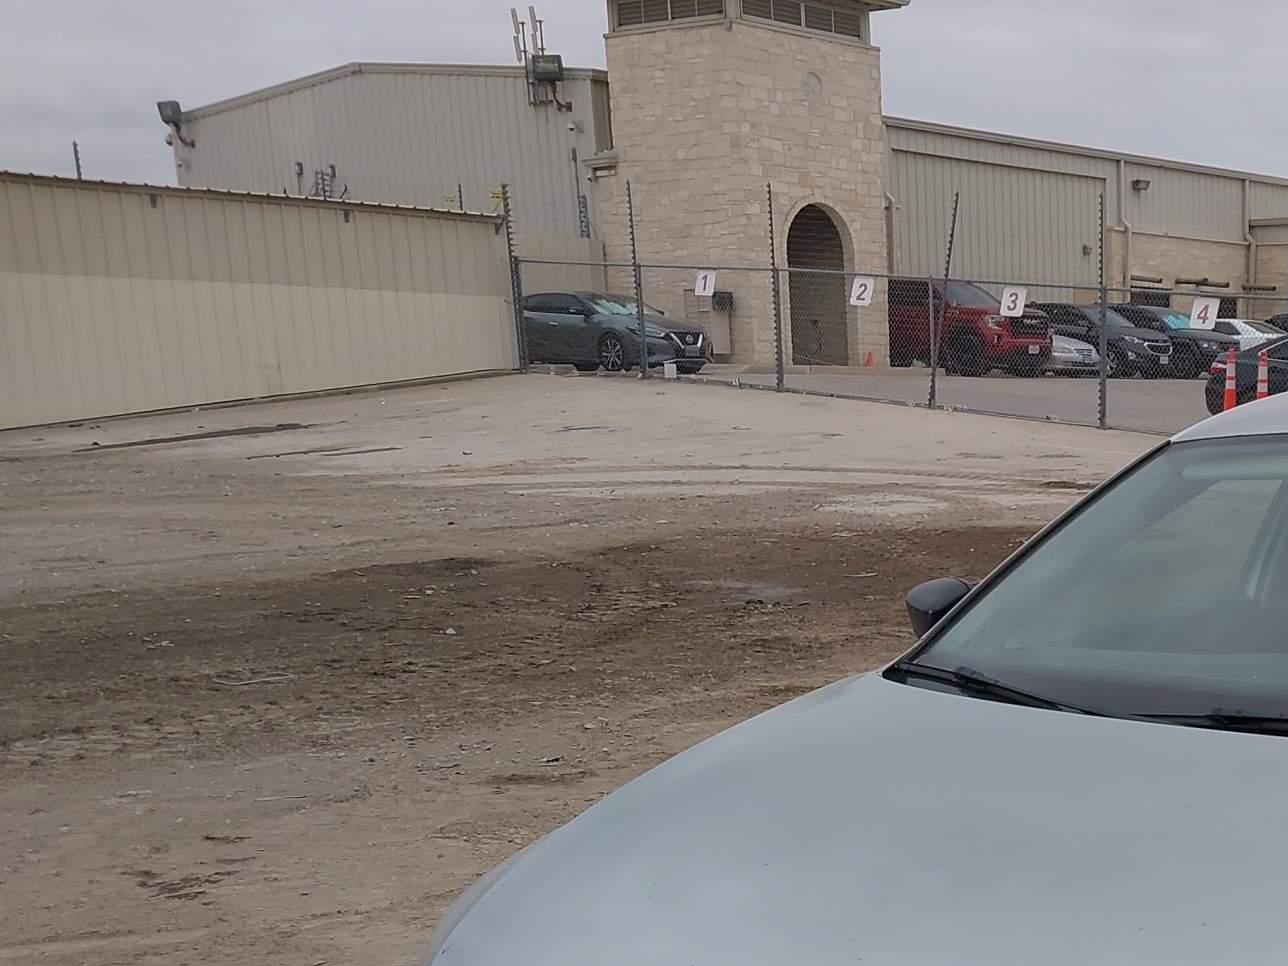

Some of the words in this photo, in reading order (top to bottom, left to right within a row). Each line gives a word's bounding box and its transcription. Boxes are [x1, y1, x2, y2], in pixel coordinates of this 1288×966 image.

[701, 274, 708, 291] 1
[856, 283, 867, 301] 2
[1007, 292, 1019, 312] 3
[1197, 304, 1210, 324] 4
